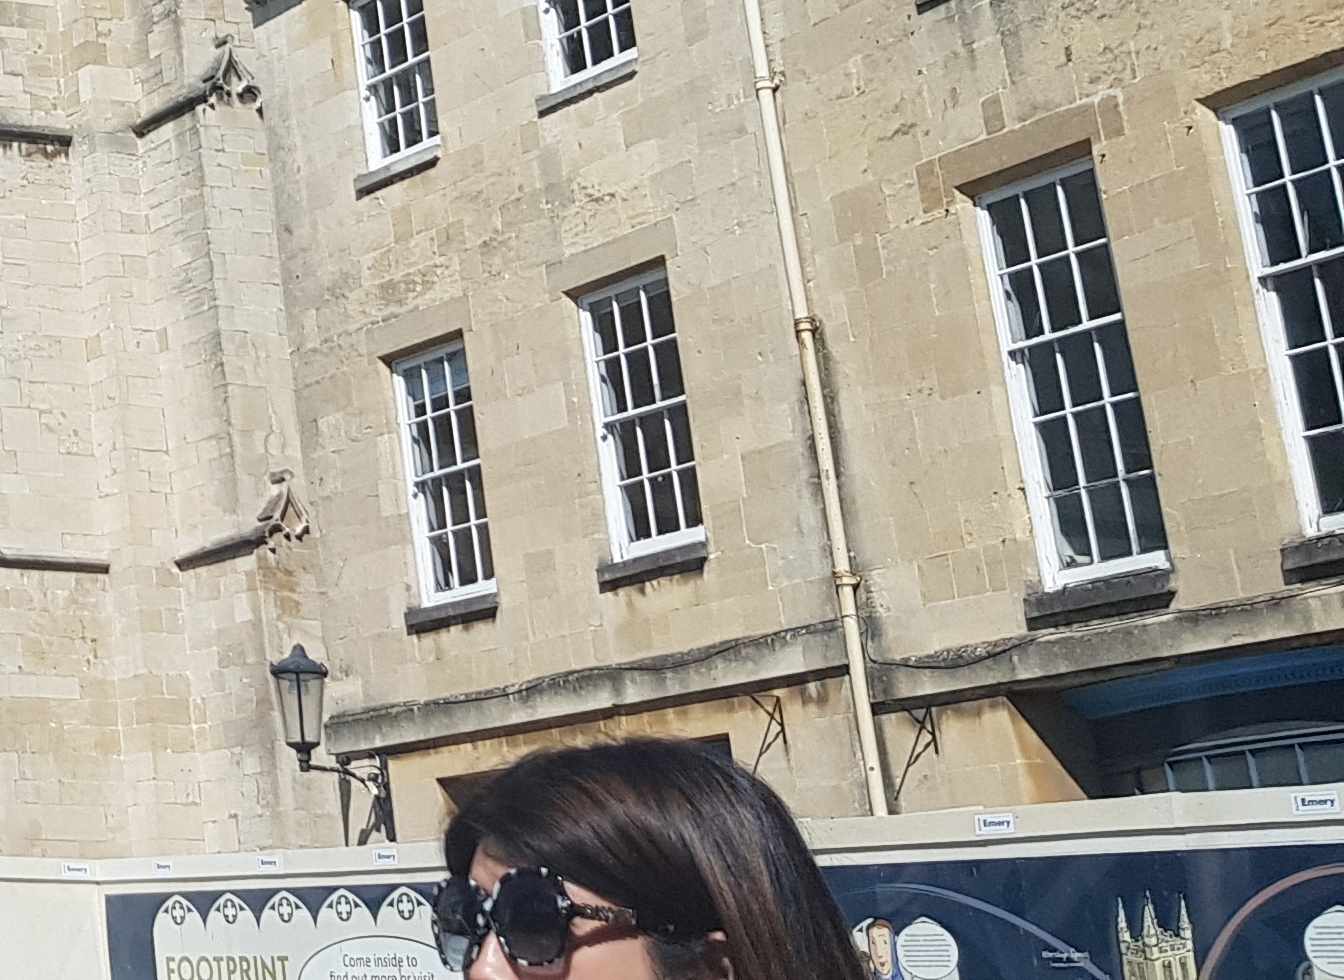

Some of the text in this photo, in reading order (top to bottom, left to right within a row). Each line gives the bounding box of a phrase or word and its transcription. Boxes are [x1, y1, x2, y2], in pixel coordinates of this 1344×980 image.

[1300, 797, 1335, 808] Emery
[983, 819, 1010, 828] Emery
[377, 852, 395, 861] Emery
[342, 953, 418, 968] Come inside to
[165, 955, 289, 980] FOOTPRINT
